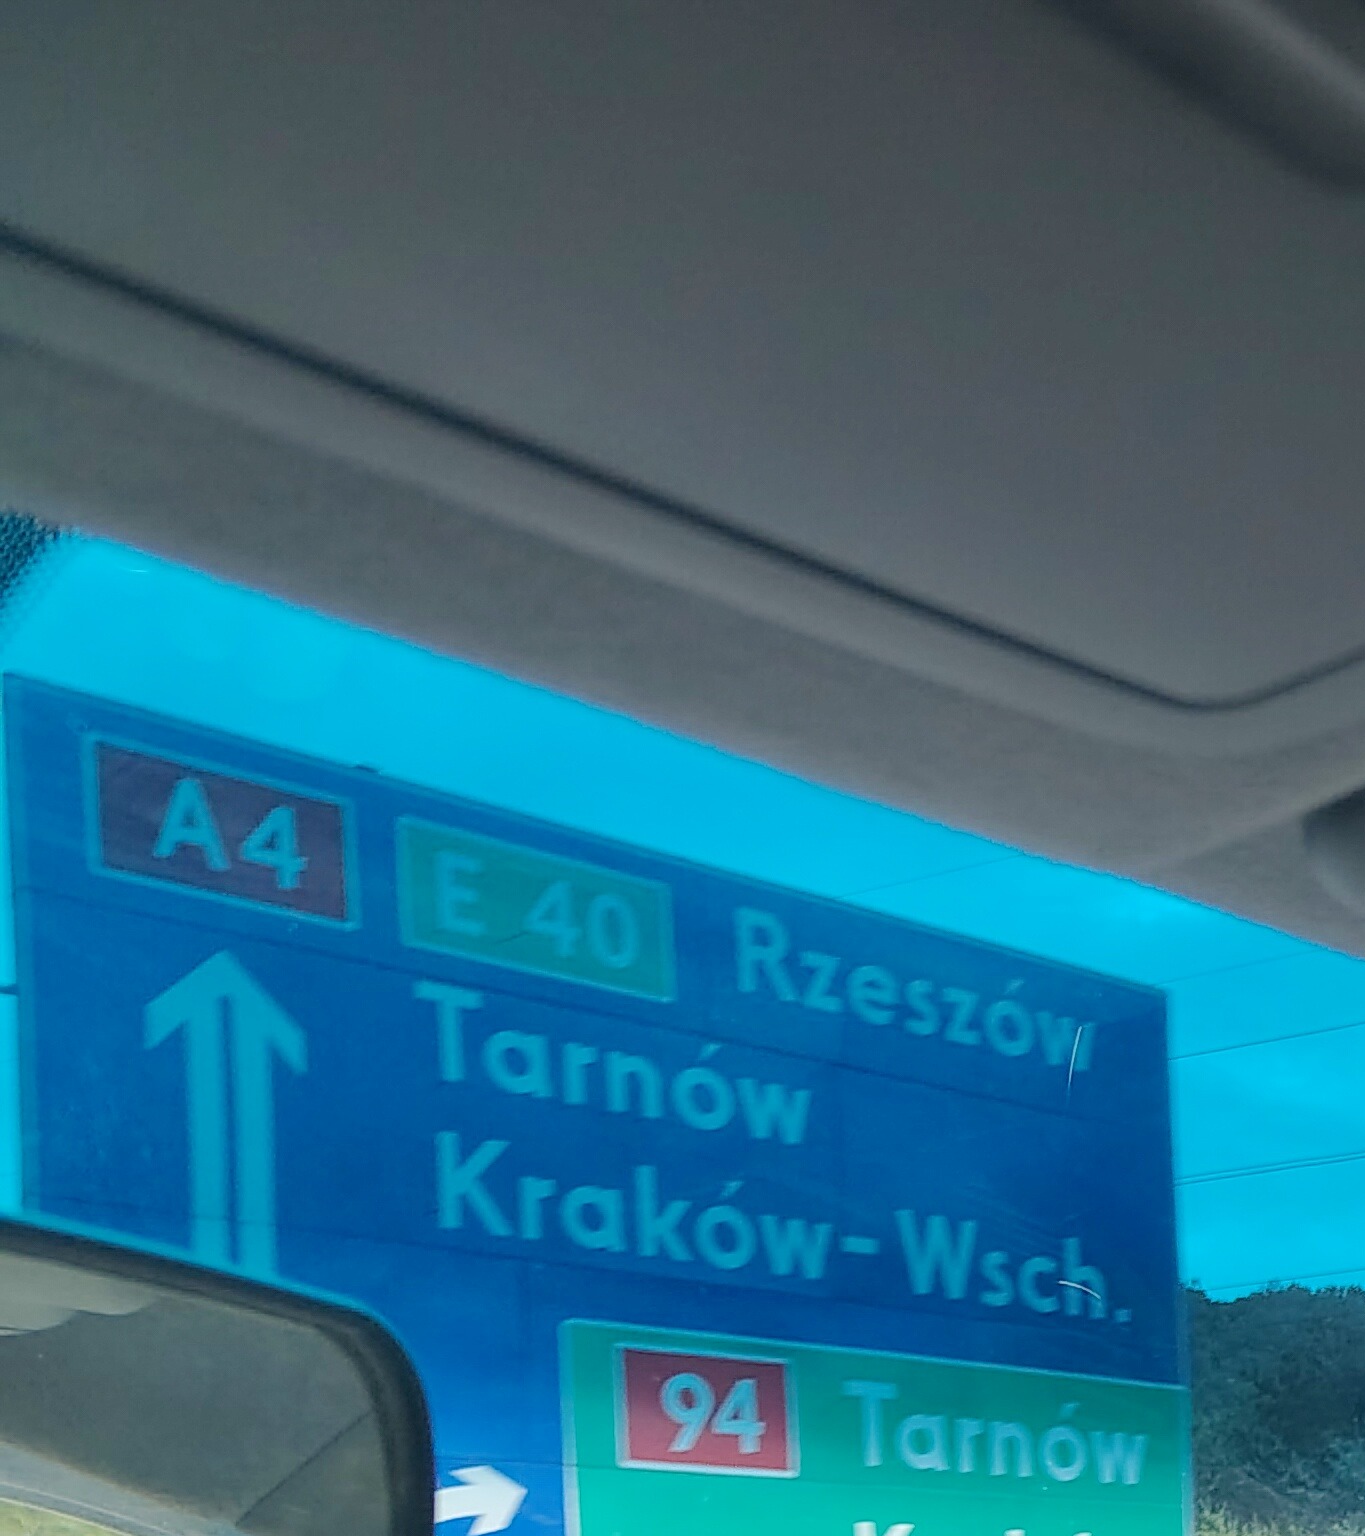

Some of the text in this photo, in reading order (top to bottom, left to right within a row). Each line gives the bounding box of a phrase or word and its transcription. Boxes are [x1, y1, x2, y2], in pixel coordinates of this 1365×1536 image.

[153, 777, 308, 890] A4
[434, 850, 639, 968] E 40
[733, 906, 1095, 1073] Rzeszów
[414, 980, 811, 1144] Tarnów
[660, 1372, 767, 1454] 94
[842, 1379, 1148, 1485] Tarnów
